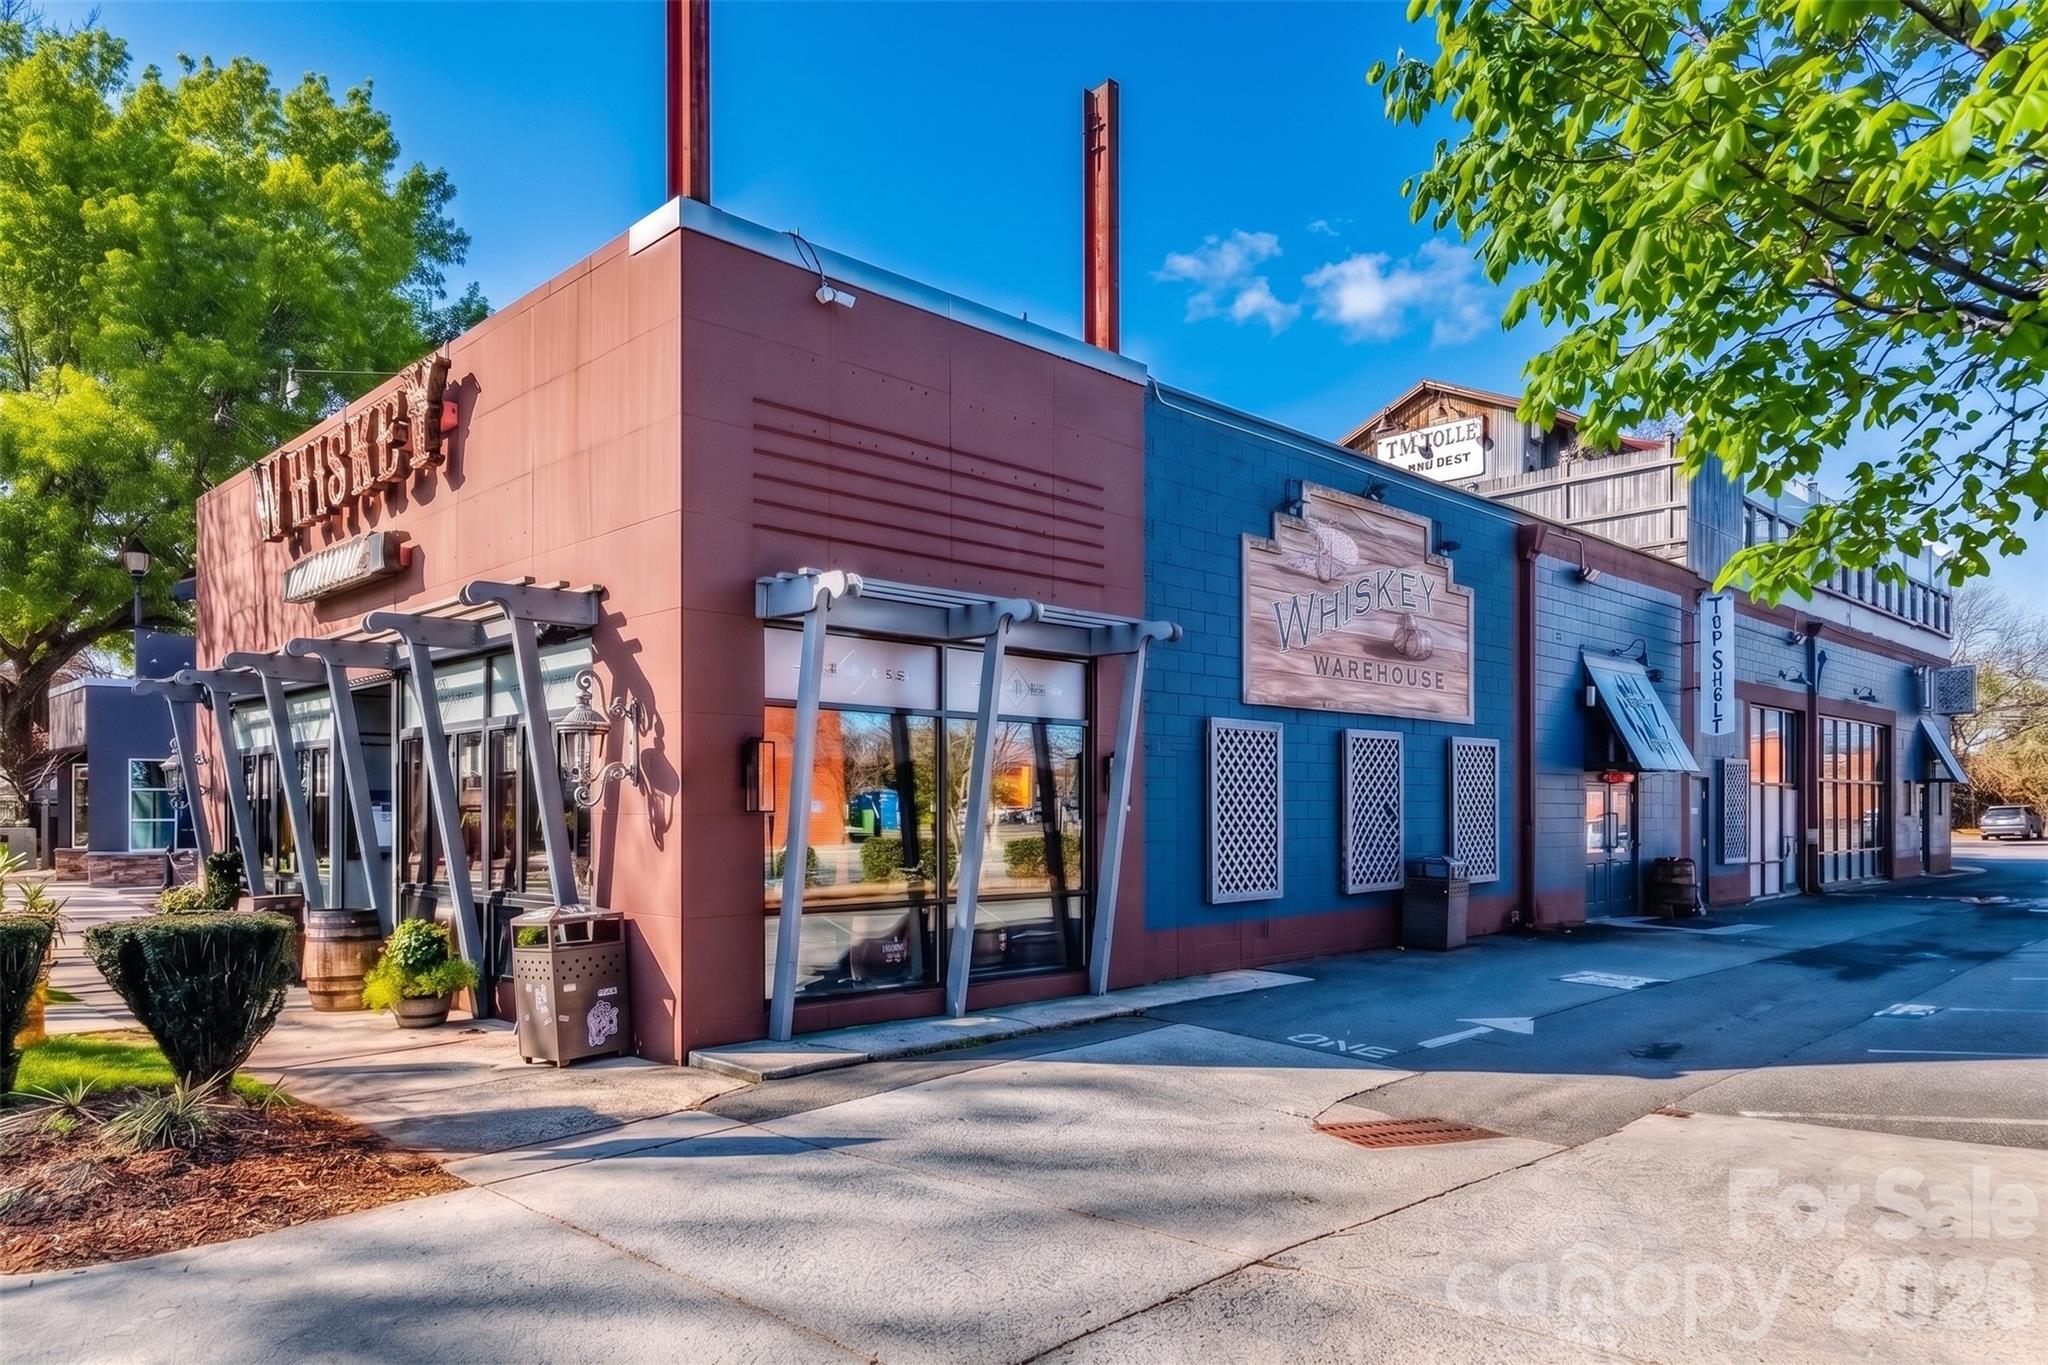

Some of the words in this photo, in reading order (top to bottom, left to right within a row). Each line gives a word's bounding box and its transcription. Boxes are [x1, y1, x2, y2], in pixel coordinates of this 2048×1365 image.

[251, 352, 446, 543] WHISKEY
[1437, 452, 1471, 467] DEST
[1272, 568, 1437, 653] WHISKEY
[1707, 596, 1723, 646] TOP
[1313, 655, 1445, 690] WAREHOUSE
[1287, 1033, 1398, 1059] ONE
